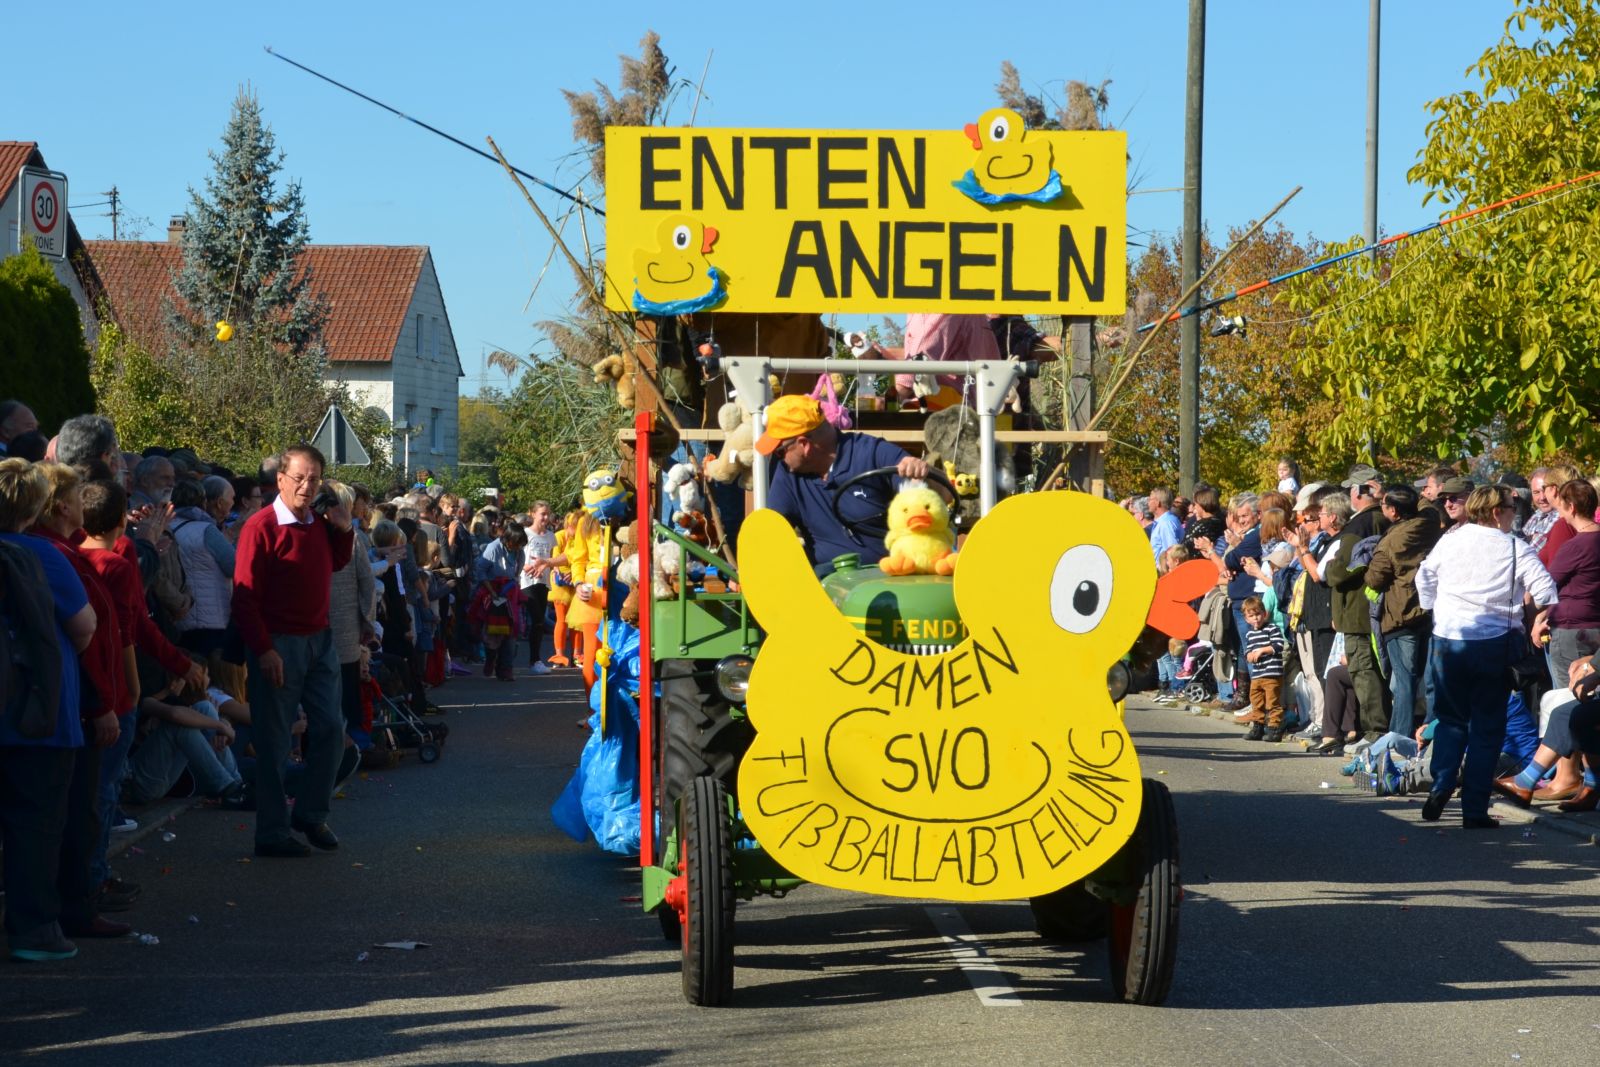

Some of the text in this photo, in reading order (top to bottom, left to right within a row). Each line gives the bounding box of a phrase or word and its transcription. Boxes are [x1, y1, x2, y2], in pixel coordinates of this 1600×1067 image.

[37, 195, 53, 219] 30
[640, 136, 926, 210] ENTEN
[775, 220, 1107, 302] ANGELN
[829, 626, 1019, 710] DAMEN
[881, 726, 990, 794] SVO
